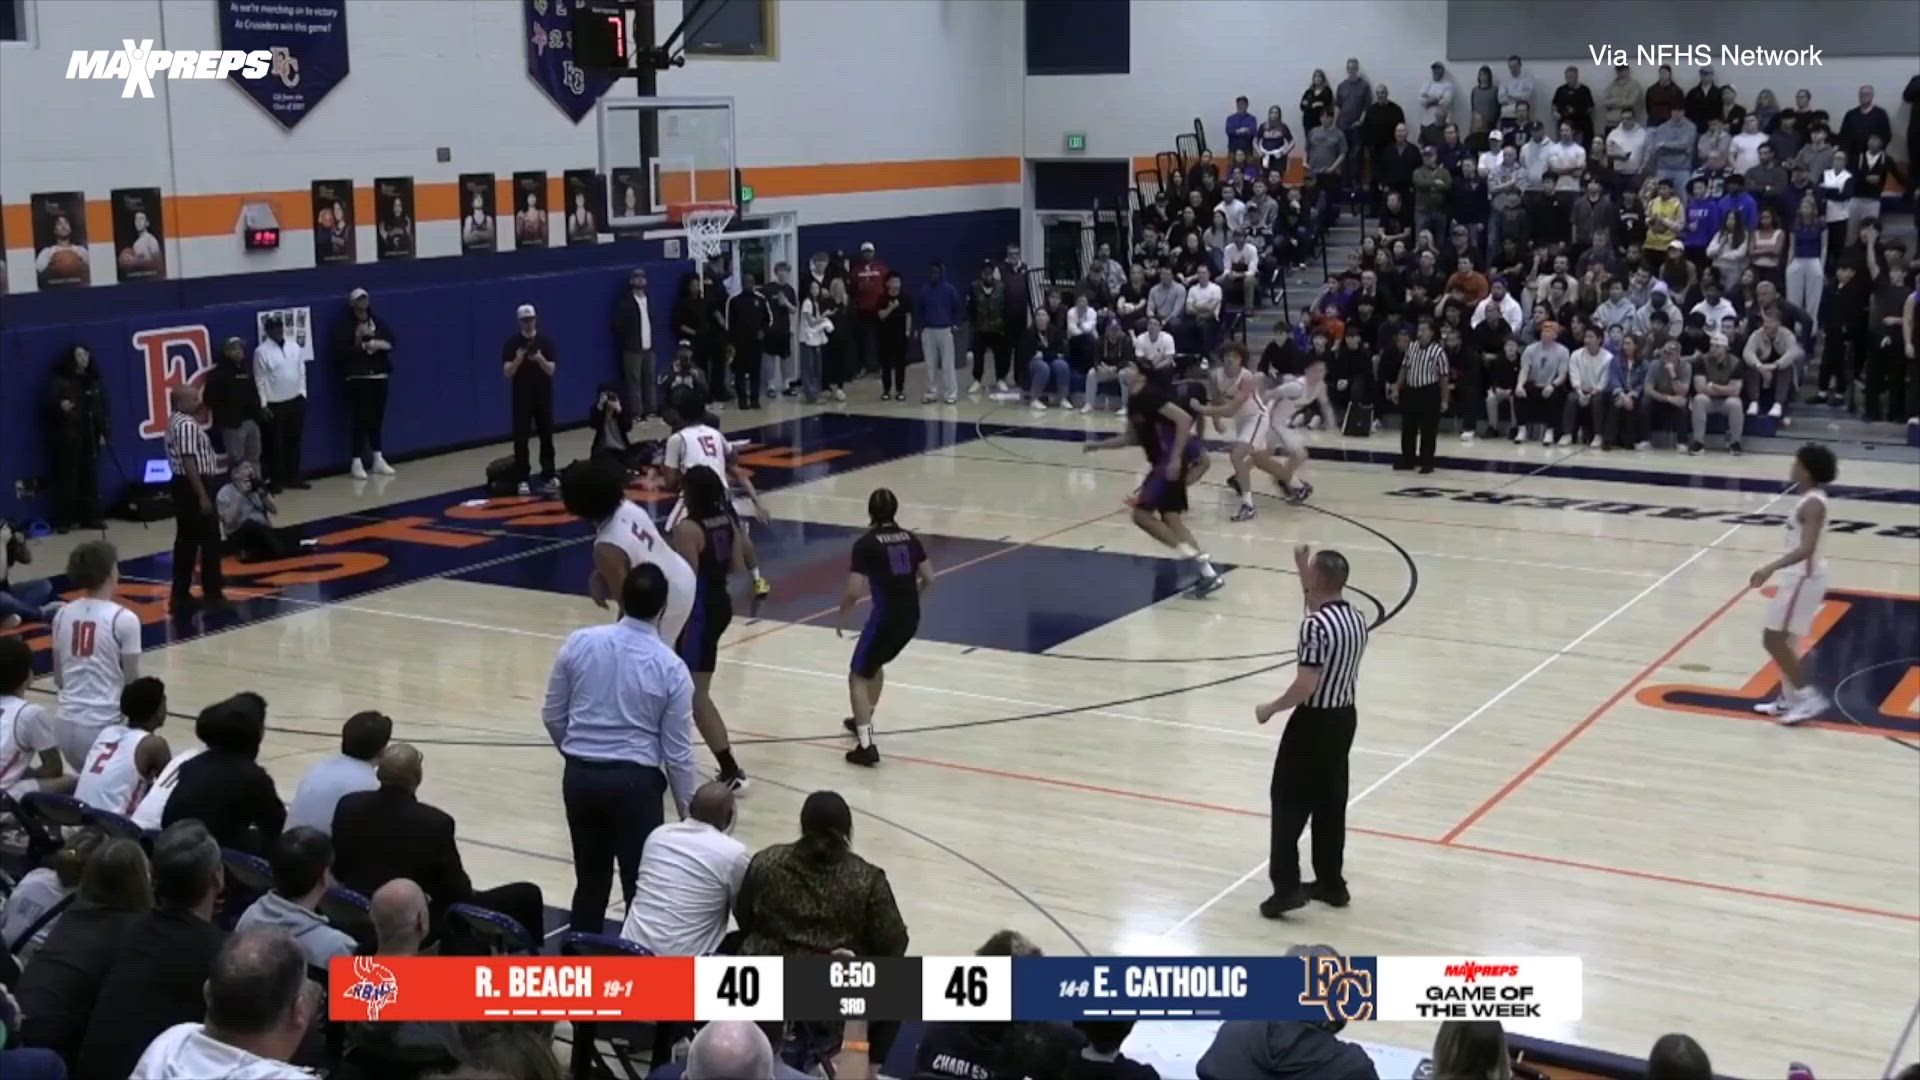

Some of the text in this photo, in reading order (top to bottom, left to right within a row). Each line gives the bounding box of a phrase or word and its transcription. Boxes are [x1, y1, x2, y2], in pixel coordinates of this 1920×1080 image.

[240, 3, 259, 13] we're
[261, 4, 294, 16] marching
[295, 7, 304, 15] on
[314, 8, 338, 18] victory
[244, 19, 279, 31] Crusaders
[280, 22, 293, 31] win
[607, 16, 624, 58] 7
[697, 433, 716, 457] 15
[630, 519, 654, 553] 5
[71, 619, 97, 658] 10
[88, 740, 121, 775] 2
